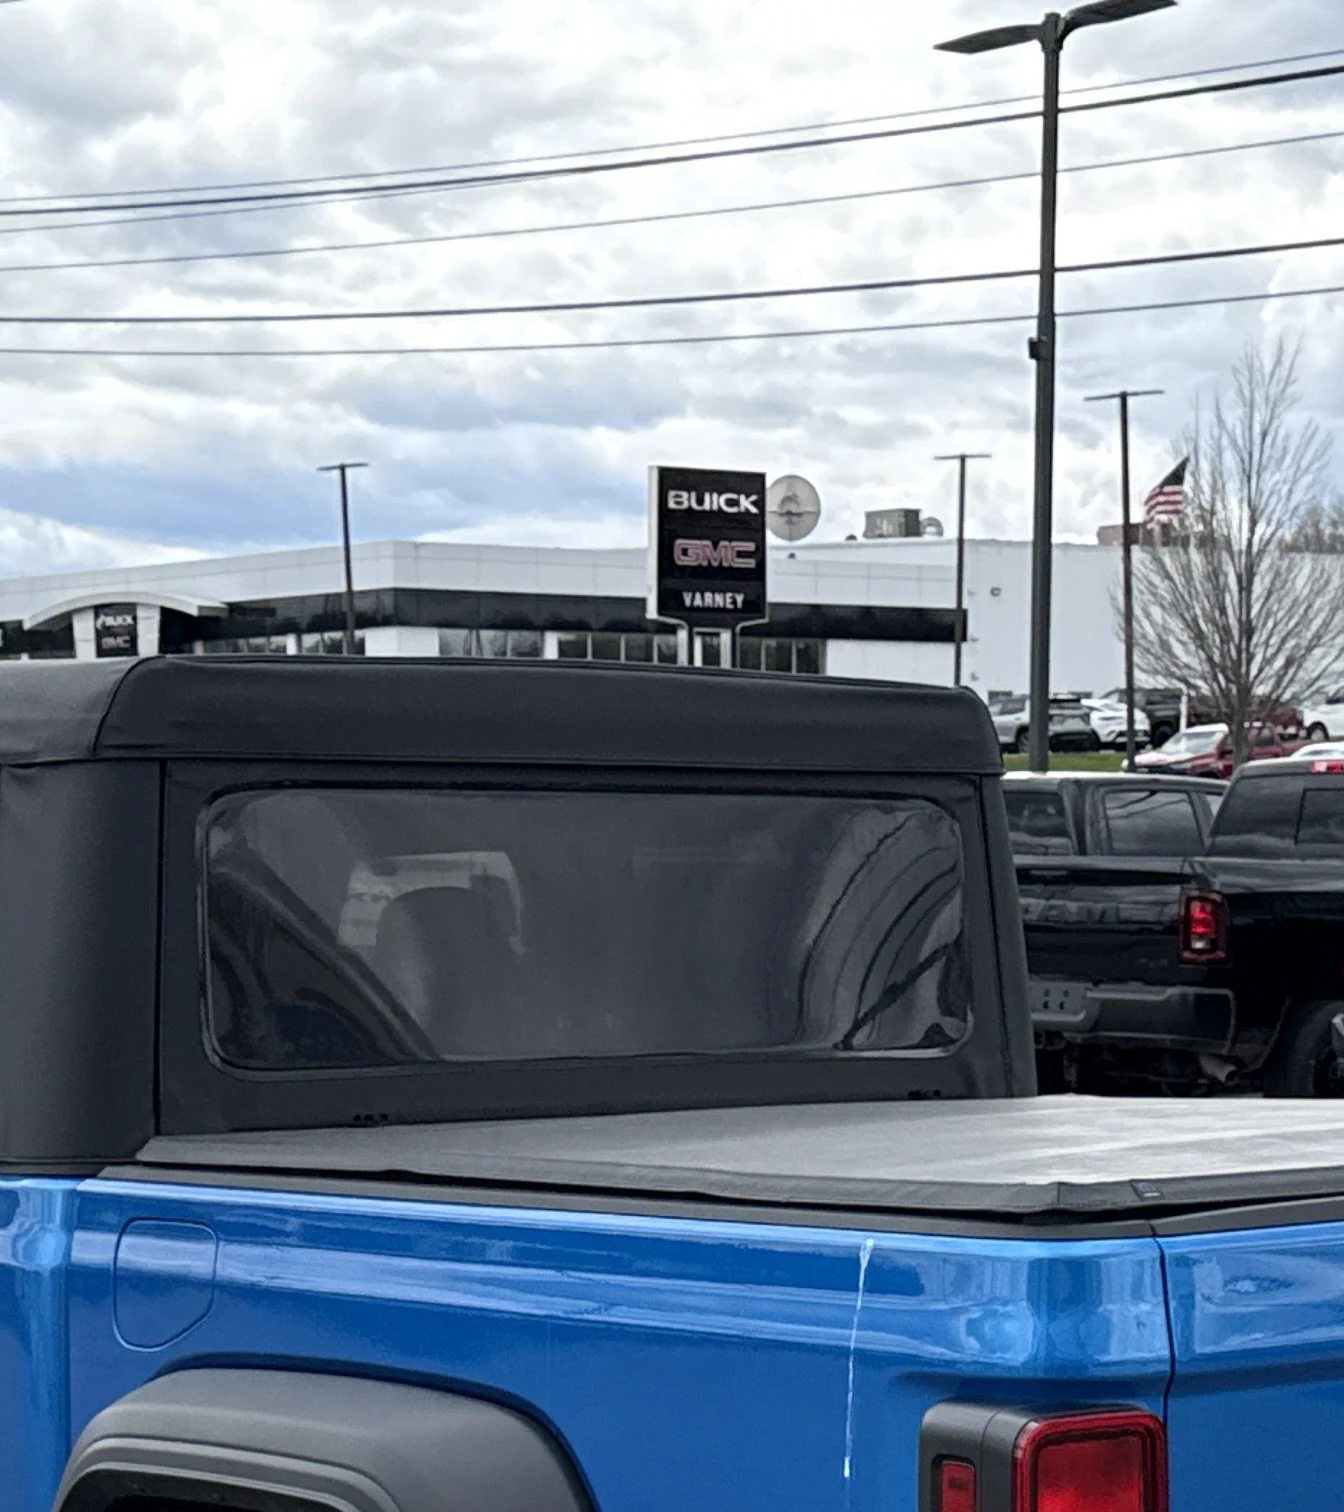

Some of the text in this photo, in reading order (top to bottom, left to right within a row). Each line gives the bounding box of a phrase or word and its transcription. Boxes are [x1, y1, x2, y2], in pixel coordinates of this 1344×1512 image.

[667, 490, 760, 514] BUICK
[673, 538, 756, 569] GMC
[682, 591, 745, 609] VARNEY
